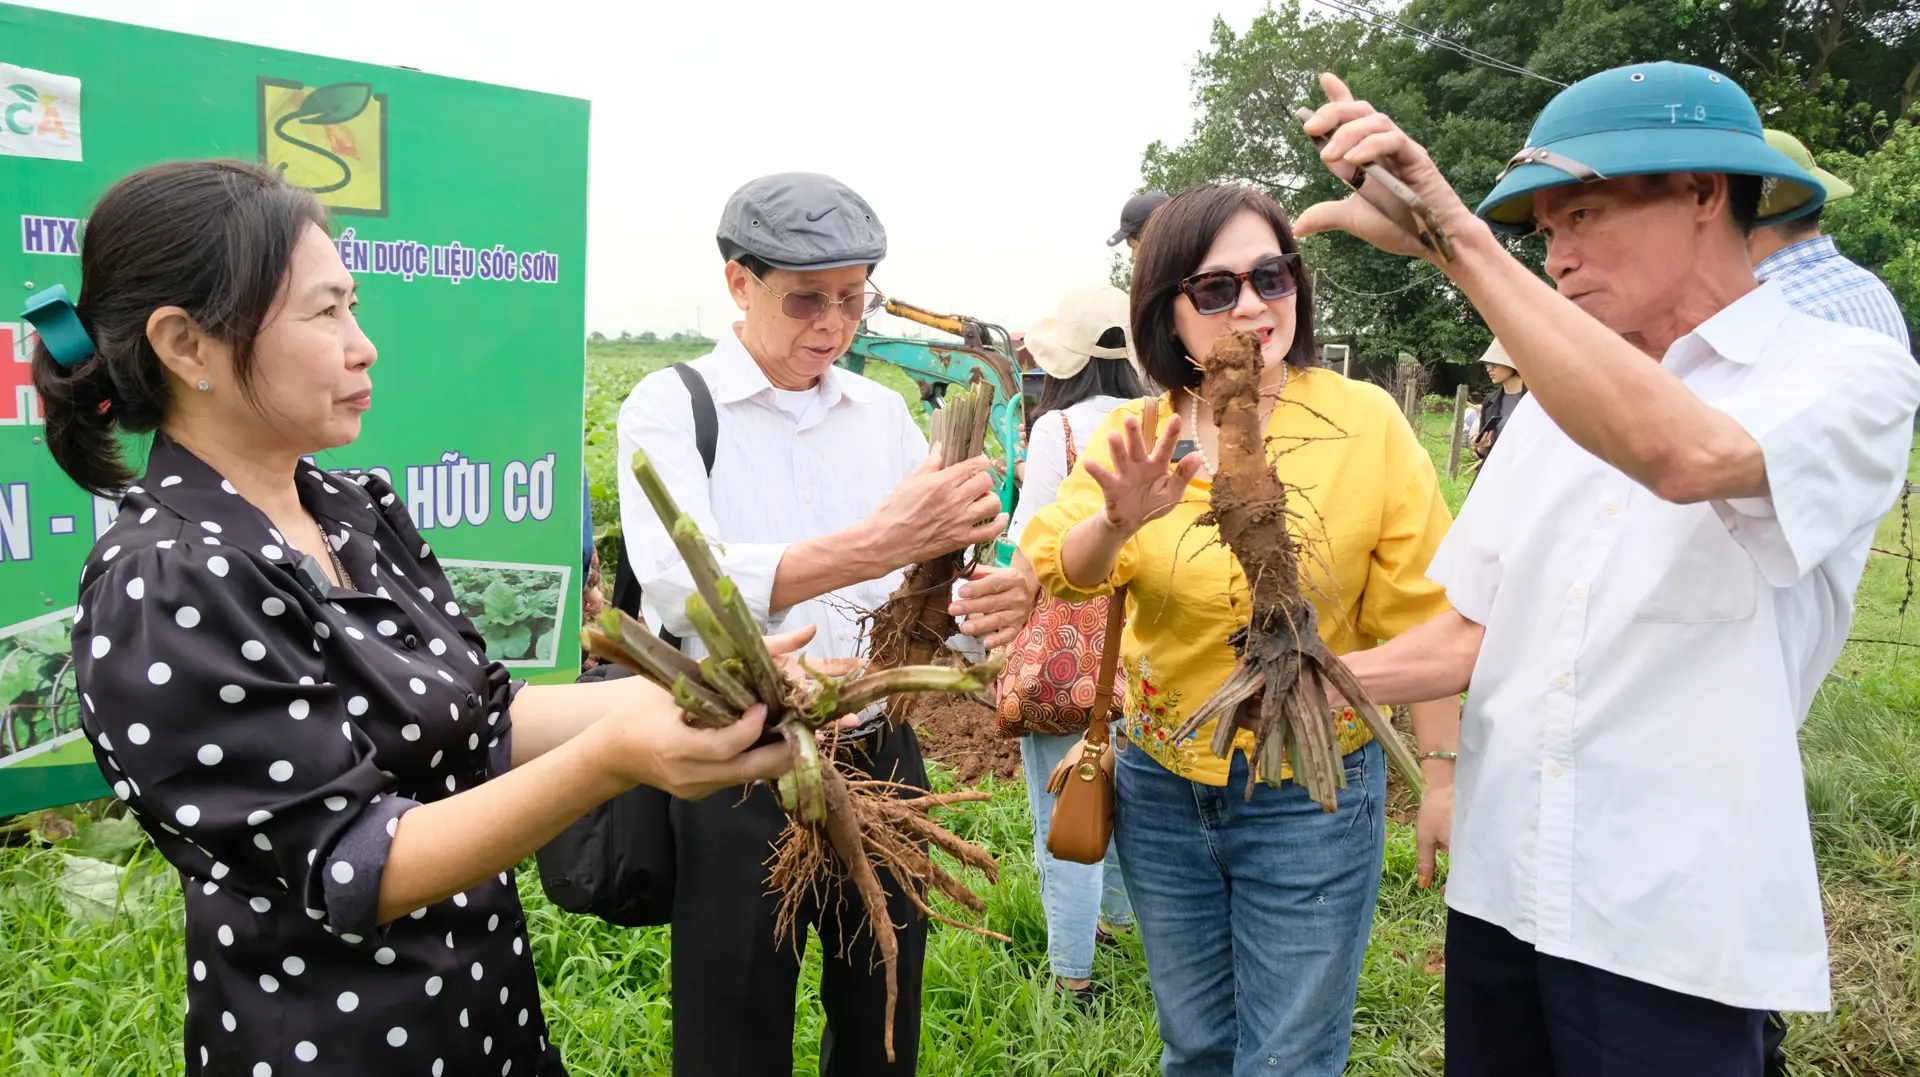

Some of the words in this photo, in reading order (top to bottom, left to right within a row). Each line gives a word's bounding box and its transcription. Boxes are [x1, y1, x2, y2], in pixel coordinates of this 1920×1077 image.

[24, 217, 78, 253] HTX
[374, 241, 428, 280] DƯỢC
[434, 243, 474, 283] LIỆU
[479, 246, 516, 280] SÓC
[521, 251, 557, 281] SƠN
[406, 450, 491, 530] HỮU
[503, 453, 556, 523] CƠ
